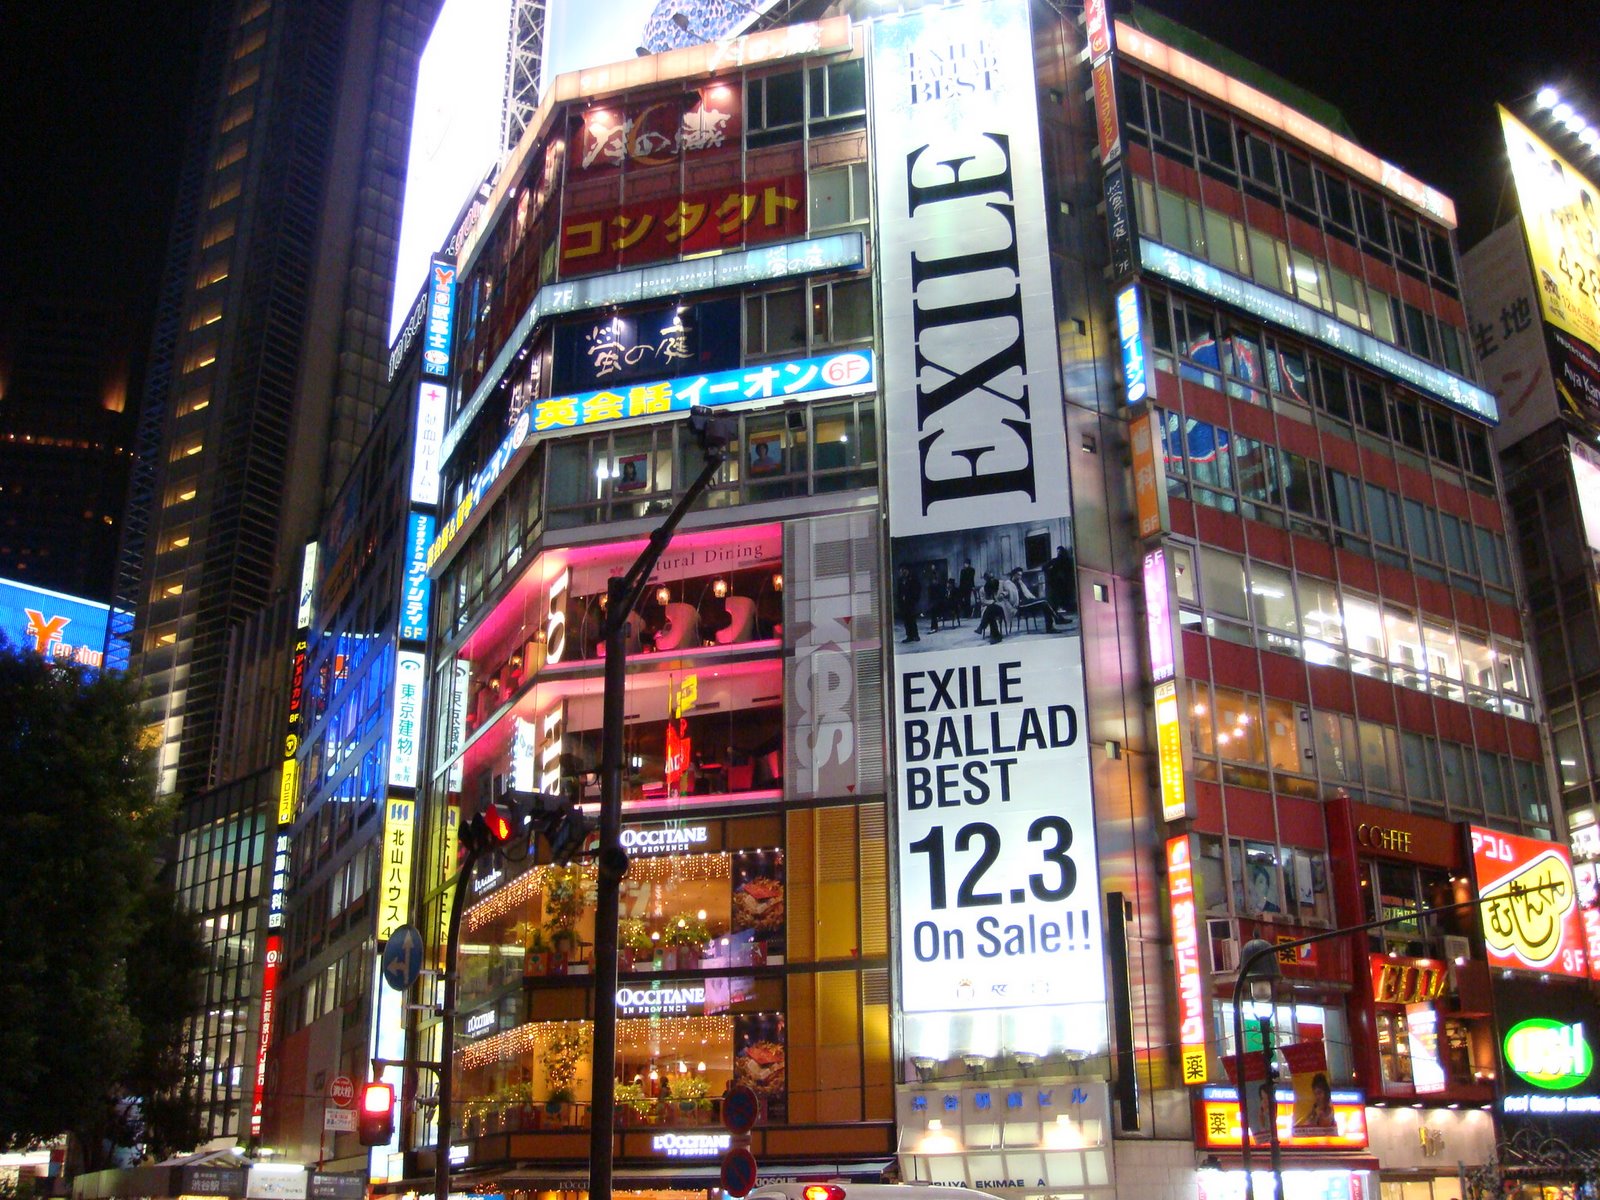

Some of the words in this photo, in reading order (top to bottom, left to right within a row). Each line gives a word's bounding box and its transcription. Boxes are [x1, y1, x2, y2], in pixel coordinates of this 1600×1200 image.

[910, 71, 999, 105] BEST
[564, 187, 798, 259] コンタクト
[635, 278, 672, 289] MODERN
[553, 290, 573, 306] 7F
[906, 132, 1037, 516] EXILE
[535, 363, 820, 429] 英会話イーオン
[828, 358, 861, 382] 6F
[656, 552, 695, 571] tural
[704, 544, 763, 564] Dining
[1144, 549, 1163, 568] 5F
[403, 625, 423, 639] 5F
[903, 661, 1023, 714] EXILE
[397, 683, 416, 756] 東京建物
[904, 704, 1078, 763] BALLAD
[906, 757, 1019, 811] BEST
[619, 827, 707, 847] OCCITANE
[642, 844, 689, 853] PROVENCE
[1357, 823, 1412, 854] COFFEE
[1471, 831, 1514, 862] アコム
[386, 829, 405, 922] 北山ハウス
[909, 815, 1077, 910] 12.3
[271, 915, 280, 926] 5F
[913, 920, 964, 962] On
[976, 909, 1090, 959] Sale!!
[1563, 949, 1585, 972] 3F
[616, 988, 705, 1006] OCCITANE
[623, 1006, 634, 1014] EN
[638, 1004, 687, 1013] PROVENCE
[1186, 1055, 1204, 1080] 薬
[1210, 1112, 1226, 1135] 薬
[975, 1179, 1025, 1189] EKIMAE
[1037, 1178, 1046, 1188] A
